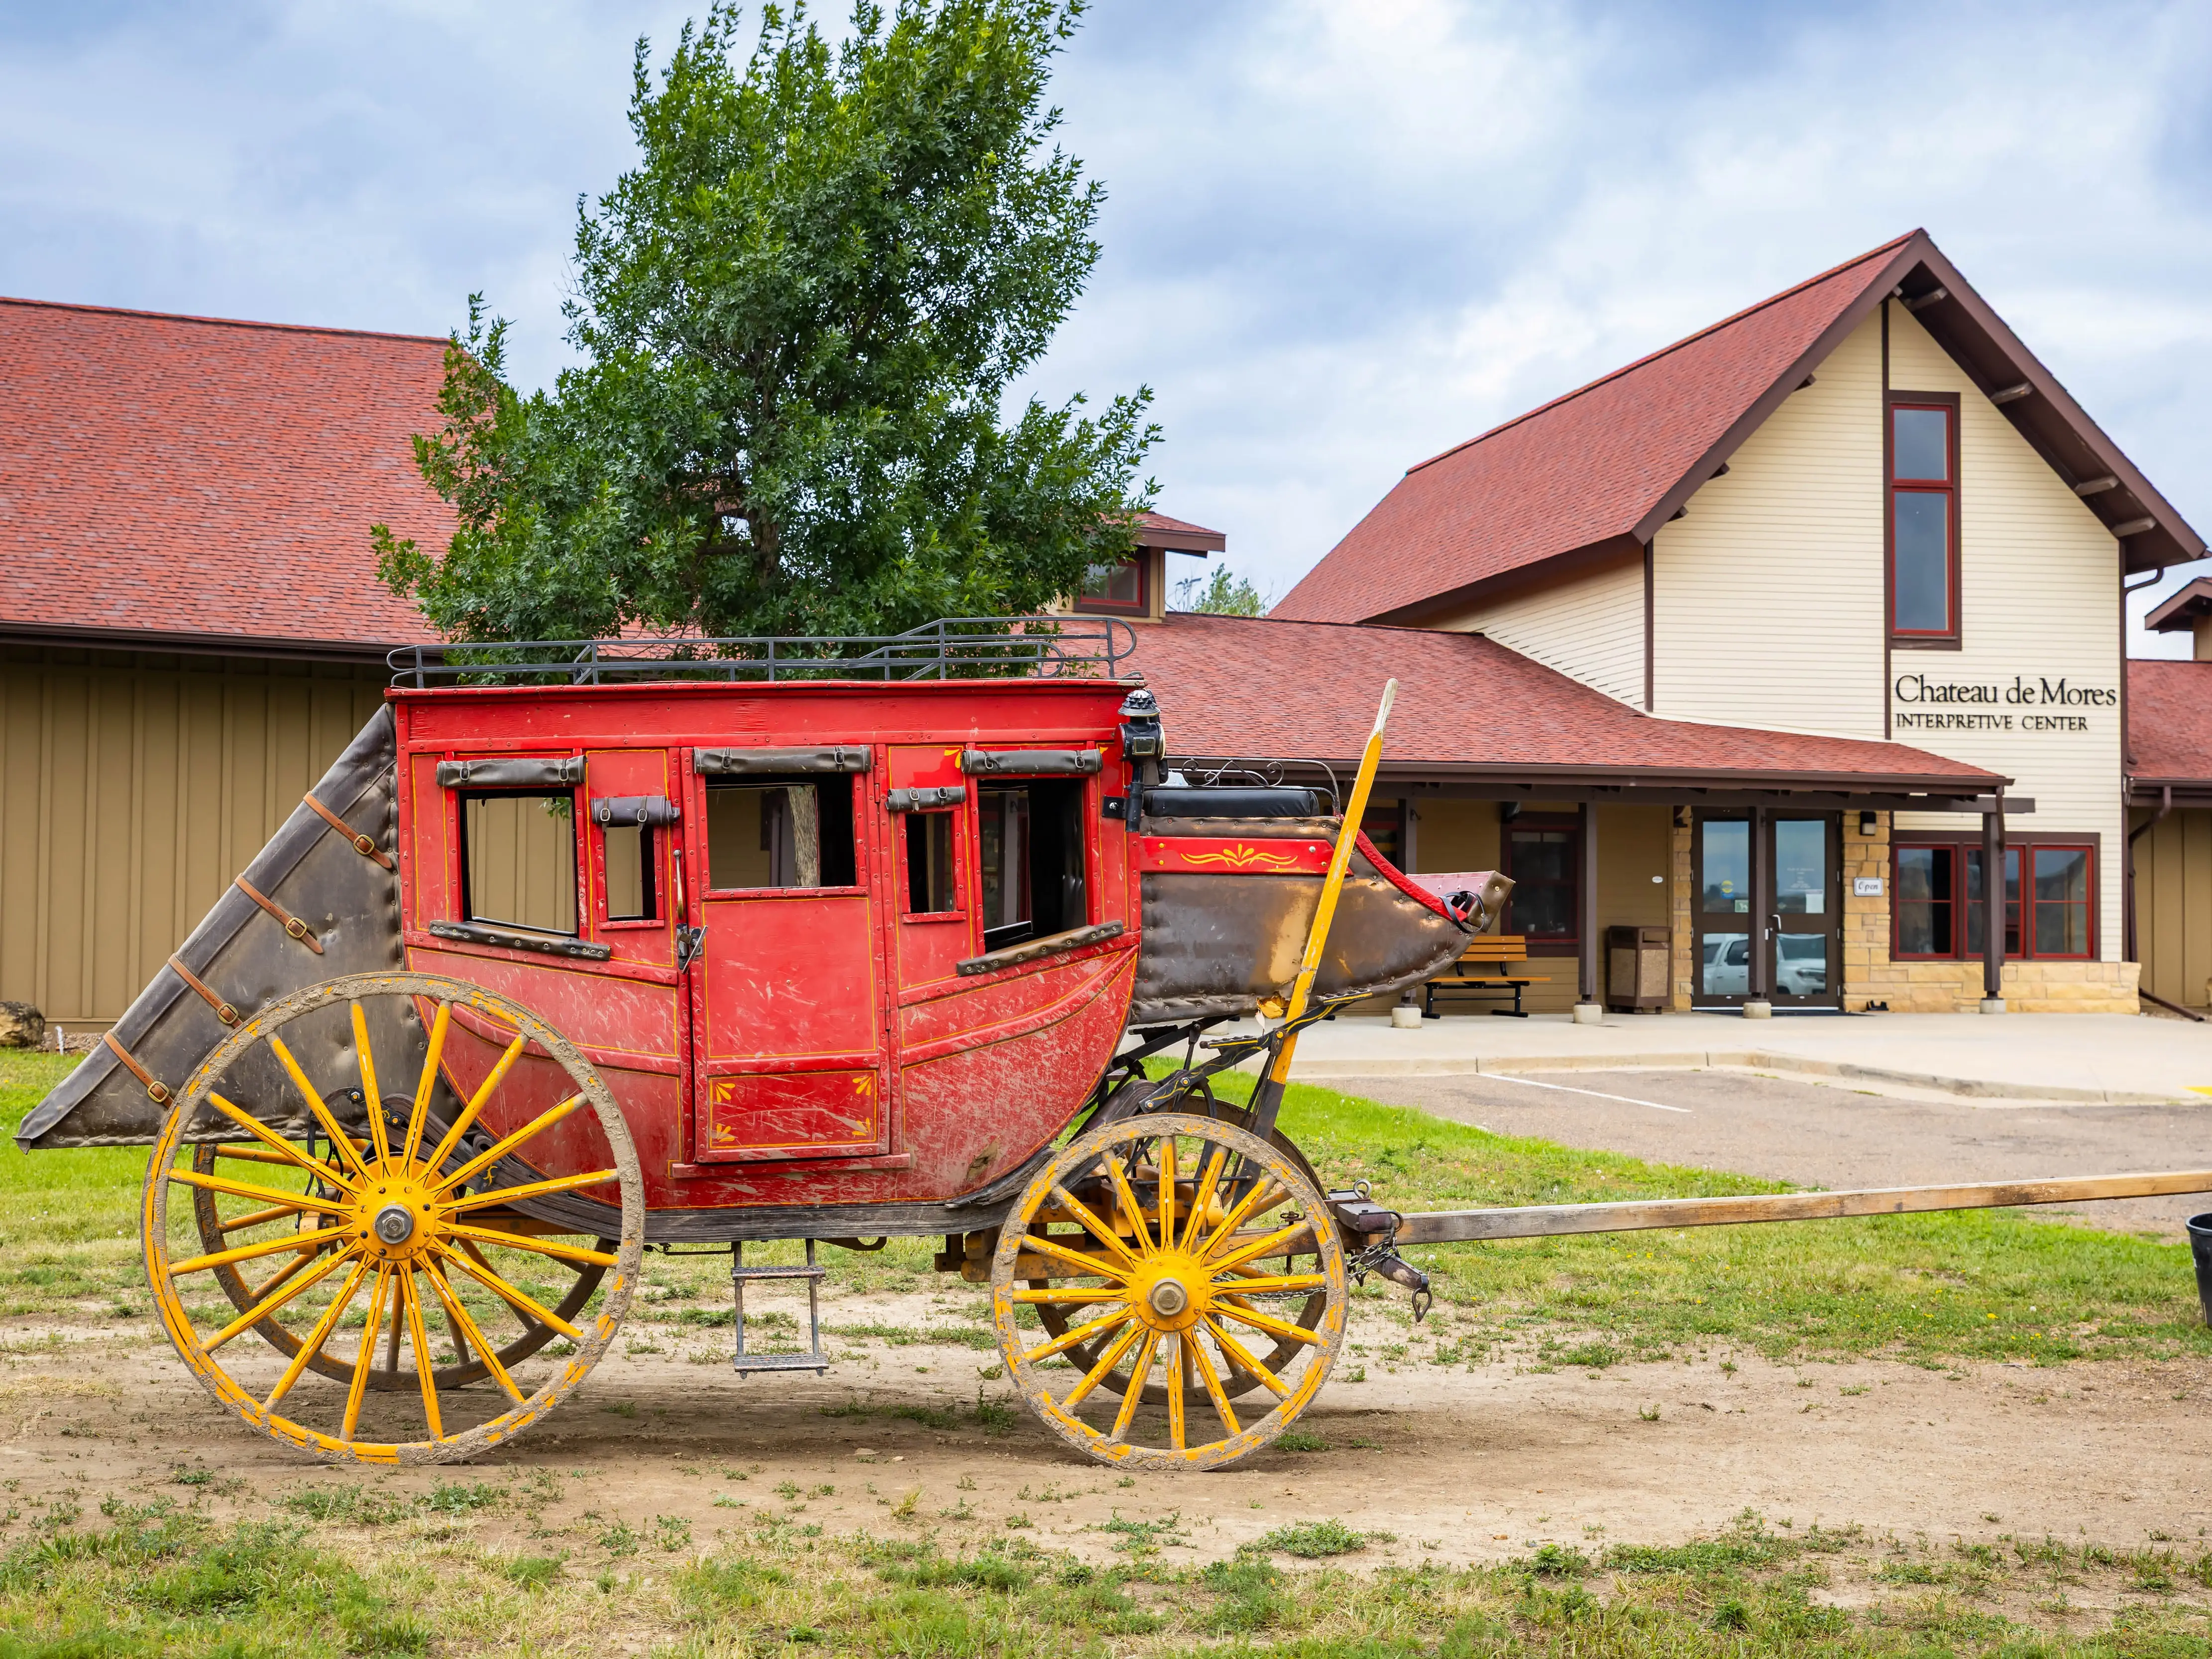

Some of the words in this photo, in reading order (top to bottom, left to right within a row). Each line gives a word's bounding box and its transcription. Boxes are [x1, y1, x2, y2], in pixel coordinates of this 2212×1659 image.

[1895, 674, 1998, 703] Chateau
[2006, 676, 2035, 704] de
[2039, 678, 2116, 705] Mores
[1896, 713, 2012, 729] INTERPRETIVE
[2021, 716, 2088, 730] CENTER
[1858, 881, 1878, 892] Open
